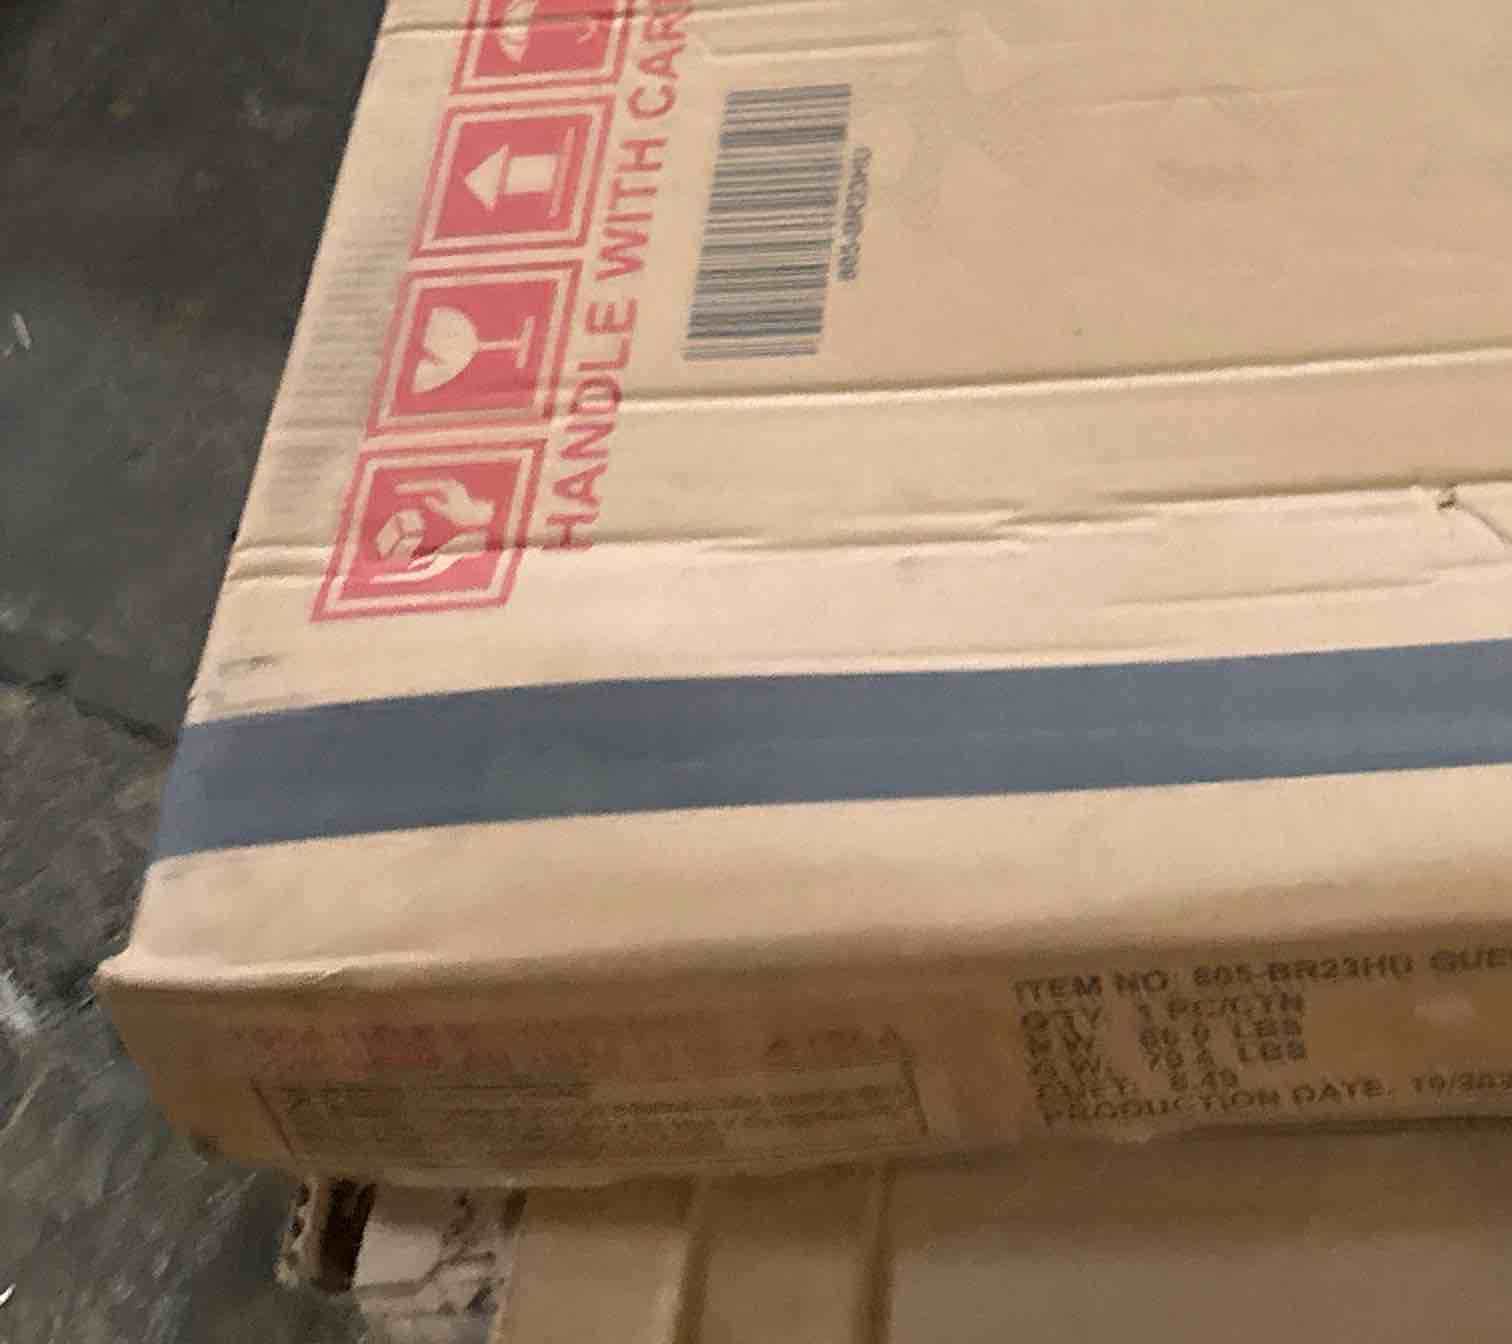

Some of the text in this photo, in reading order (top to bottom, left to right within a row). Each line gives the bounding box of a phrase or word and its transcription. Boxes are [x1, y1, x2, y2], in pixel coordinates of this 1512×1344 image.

[541, 295, 639, 554] HANDLE
[598, 134, 669, 283] WITH
[1011, 974, 1103, 1004] ITEM
